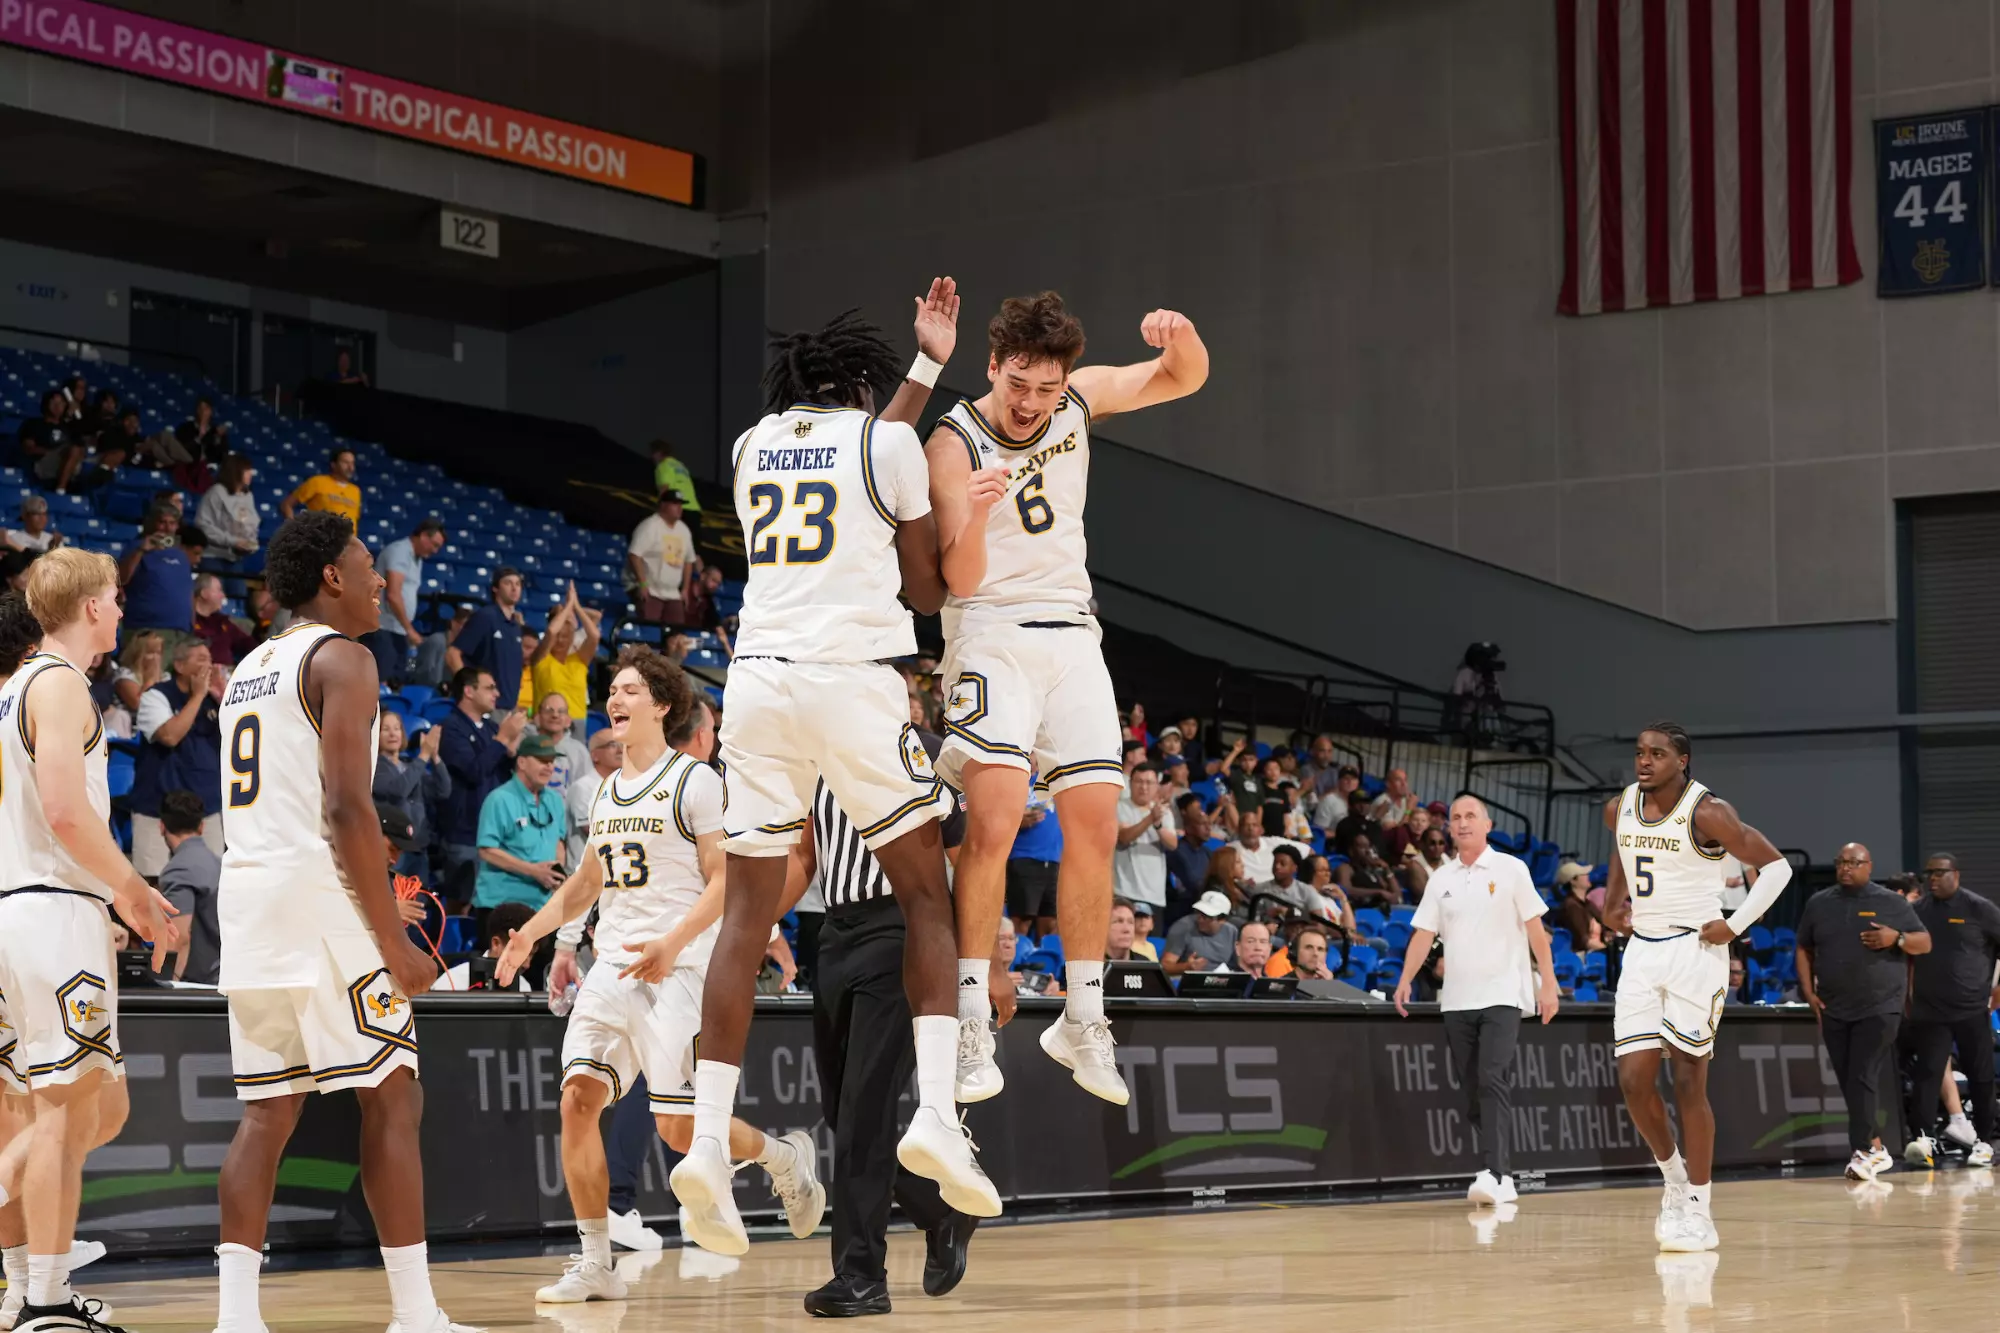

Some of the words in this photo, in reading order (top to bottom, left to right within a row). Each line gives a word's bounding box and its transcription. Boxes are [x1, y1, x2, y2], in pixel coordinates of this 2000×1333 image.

[114, 25, 259, 90] PASSION
[350, 83, 499, 147] TROPICAL
[506, 122, 626, 179] PASSION
[1896, 125, 1915, 140] UC
[1918, 120, 1966, 137] IRVINE
[1889, 152, 1972, 180] MAGEE
[1894, 181, 1968, 227] 44
[453, 217, 486, 249] 122
[758, 447, 837, 471] EMENEKE
[750, 480, 839, 567] 23
[1014, 472, 1056, 536] 6
[229, 711, 262, 809] 9
[607, 817, 664, 834] IRVINE
[1619, 834, 1631, 847] UC
[1634, 835, 1680, 852] IRVINE
[598, 841, 650, 889] 13
[1634, 855, 1655, 898] 5
[1124, 975, 1142, 989] POSS
[468, 1048, 557, 1111] THE
[1114, 1046, 1283, 1134] TCS
[1386, 1044, 1438, 1092] THE
[1426, 1107, 1462, 1156] UC
